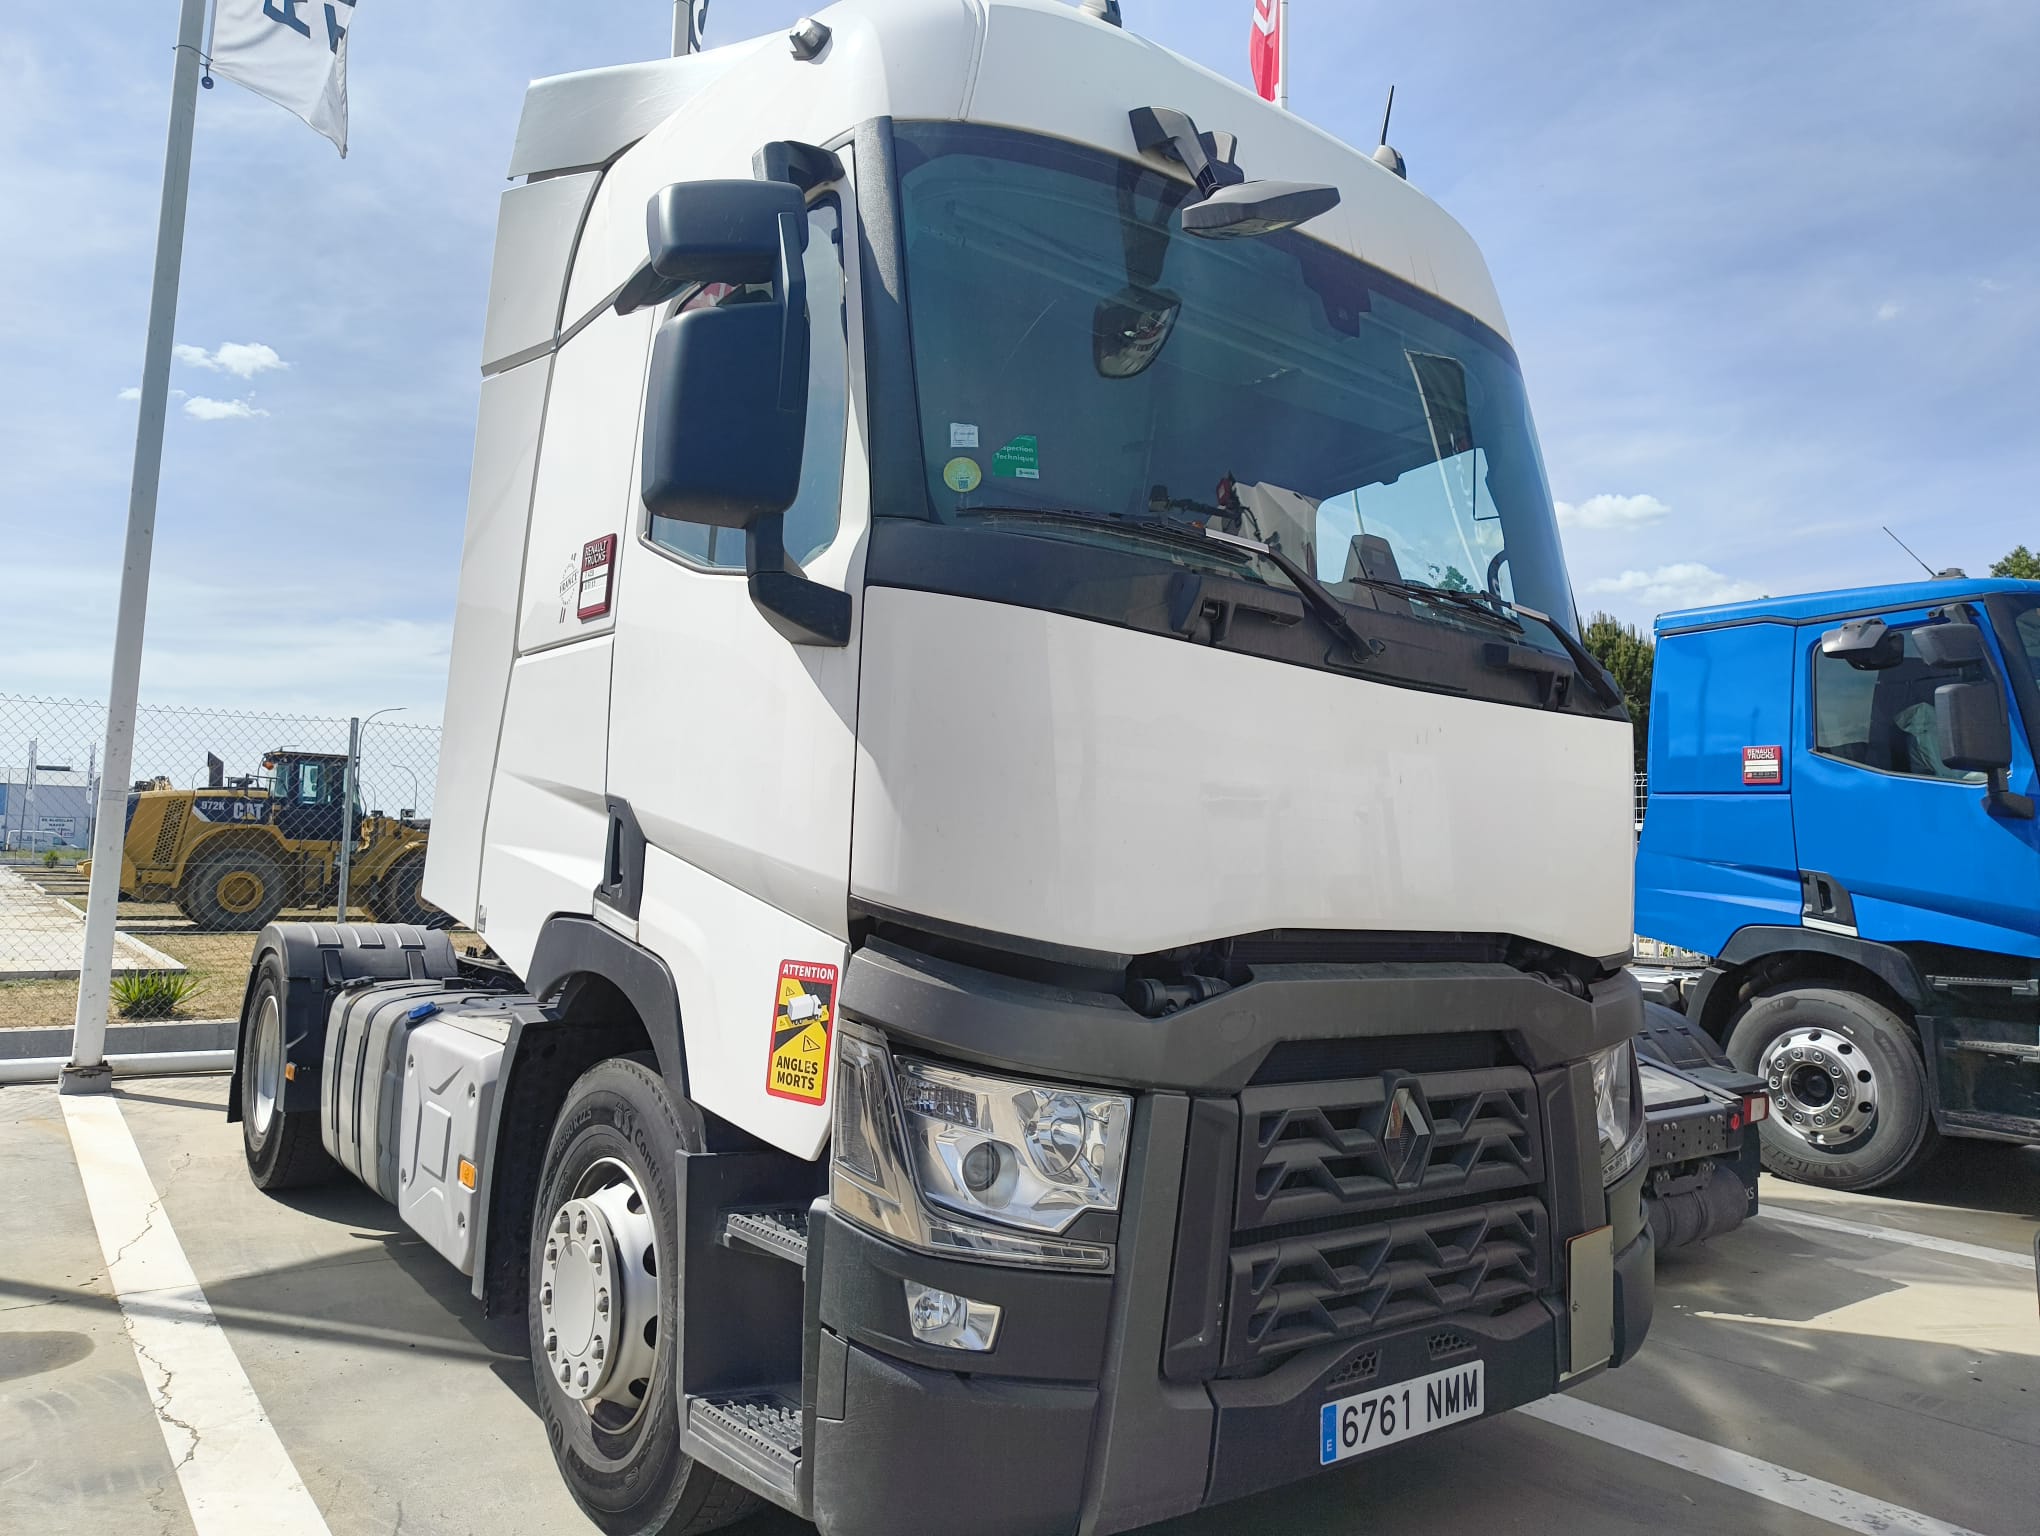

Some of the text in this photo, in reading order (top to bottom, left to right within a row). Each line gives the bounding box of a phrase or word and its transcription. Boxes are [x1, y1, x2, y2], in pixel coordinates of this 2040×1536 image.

[584, 540, 608, 556] RENAULT
[584, 551, 606, 568] TRUCKS
[201, 801, 225, 810] 972K
[233, 802, 264, 820] CAT
[782, 963, 835, 981] ATTENTION
[776, 1055, 818, 1075] ANGLES
[776, 1070, 815, 1090] MORTS
[1326, 1369, 1478, 1452] E 6761 NMM
